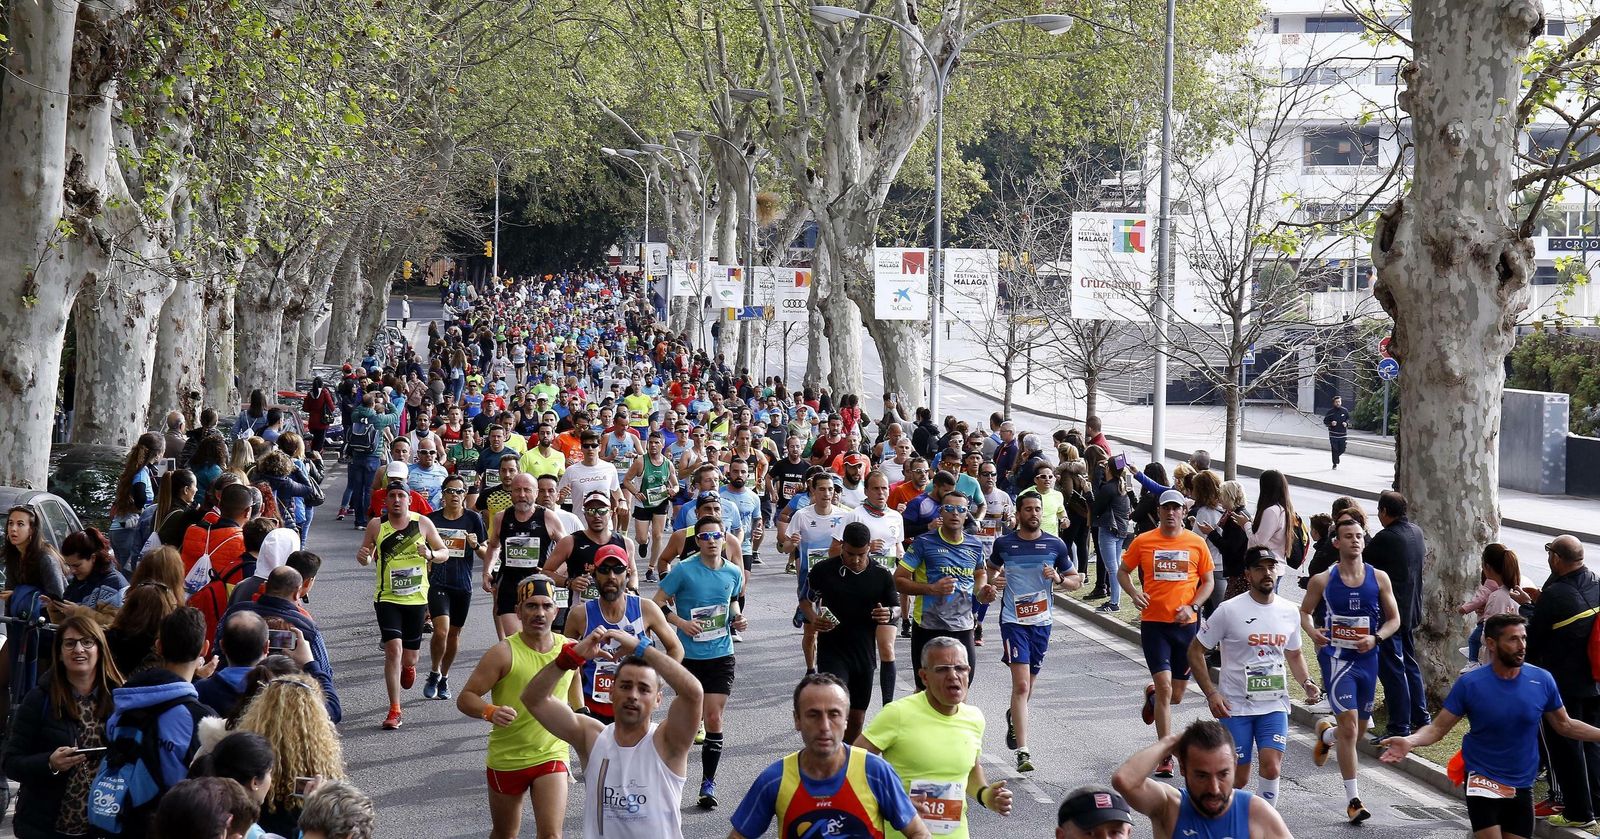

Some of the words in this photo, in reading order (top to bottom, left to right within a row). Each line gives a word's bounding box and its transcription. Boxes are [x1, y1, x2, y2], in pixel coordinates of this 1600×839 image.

[955, 258, 974, 272] 22
[580, 475, 607, 484] ORACLE
[1157, 561, 1177, 570] 4415
[394, 579, 412, 587] 2071
[1019, 604, 1039, 614] 3875
[1335, 628, 1357, 637] 4053
[1248, 633, 1288, 647] SEUR
[1251, 679, 1272, 688] 1761
[603, 786, 647, 813] Priego
